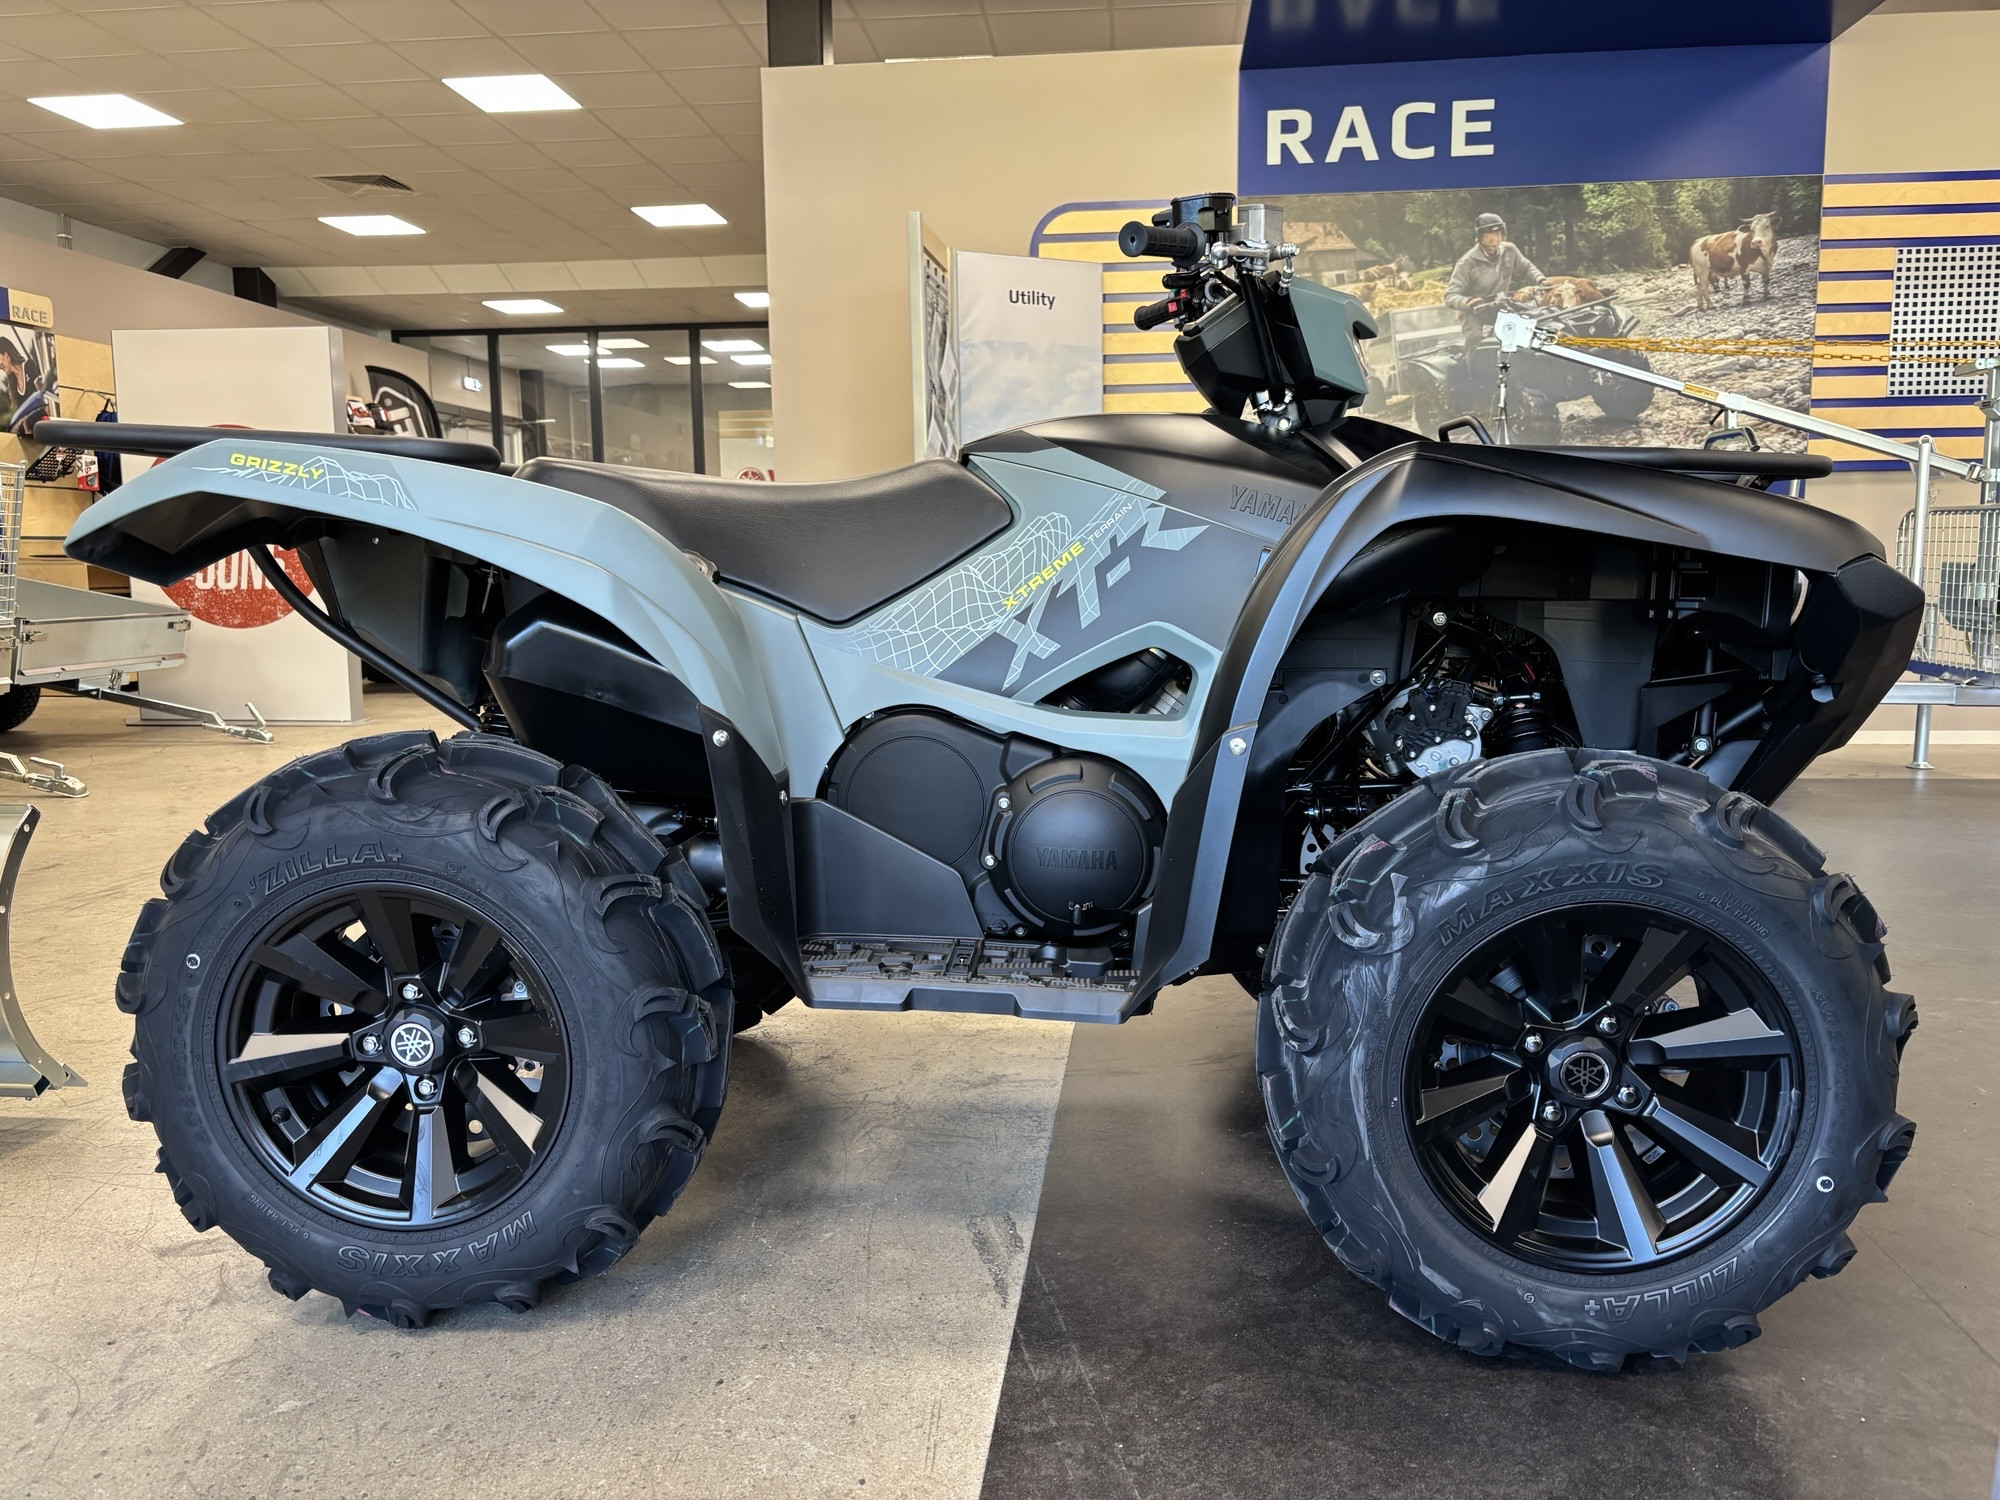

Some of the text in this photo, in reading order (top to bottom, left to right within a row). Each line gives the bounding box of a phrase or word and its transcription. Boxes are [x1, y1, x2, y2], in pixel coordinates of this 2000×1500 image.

[1266, 98, 1496, 166] RACE
[12, 305, 48, 325] RACE
[1008, 289, 1056, 311] Utility
[229, 453, 325, 480] GRIZZLY
[1086, 502, 1134, 542] TERRAIN
[1229, 484, 1308, 526] YAMA
[1035, 846, 1119, 872] YAMAHA
[1435, 860, 1670, 948] MAXXIS
[1709, 896, 1732, 911] PLY
[1733, 909, 1769, 937] RATING
[336, 1210, 538, 1278] MAXXIS
